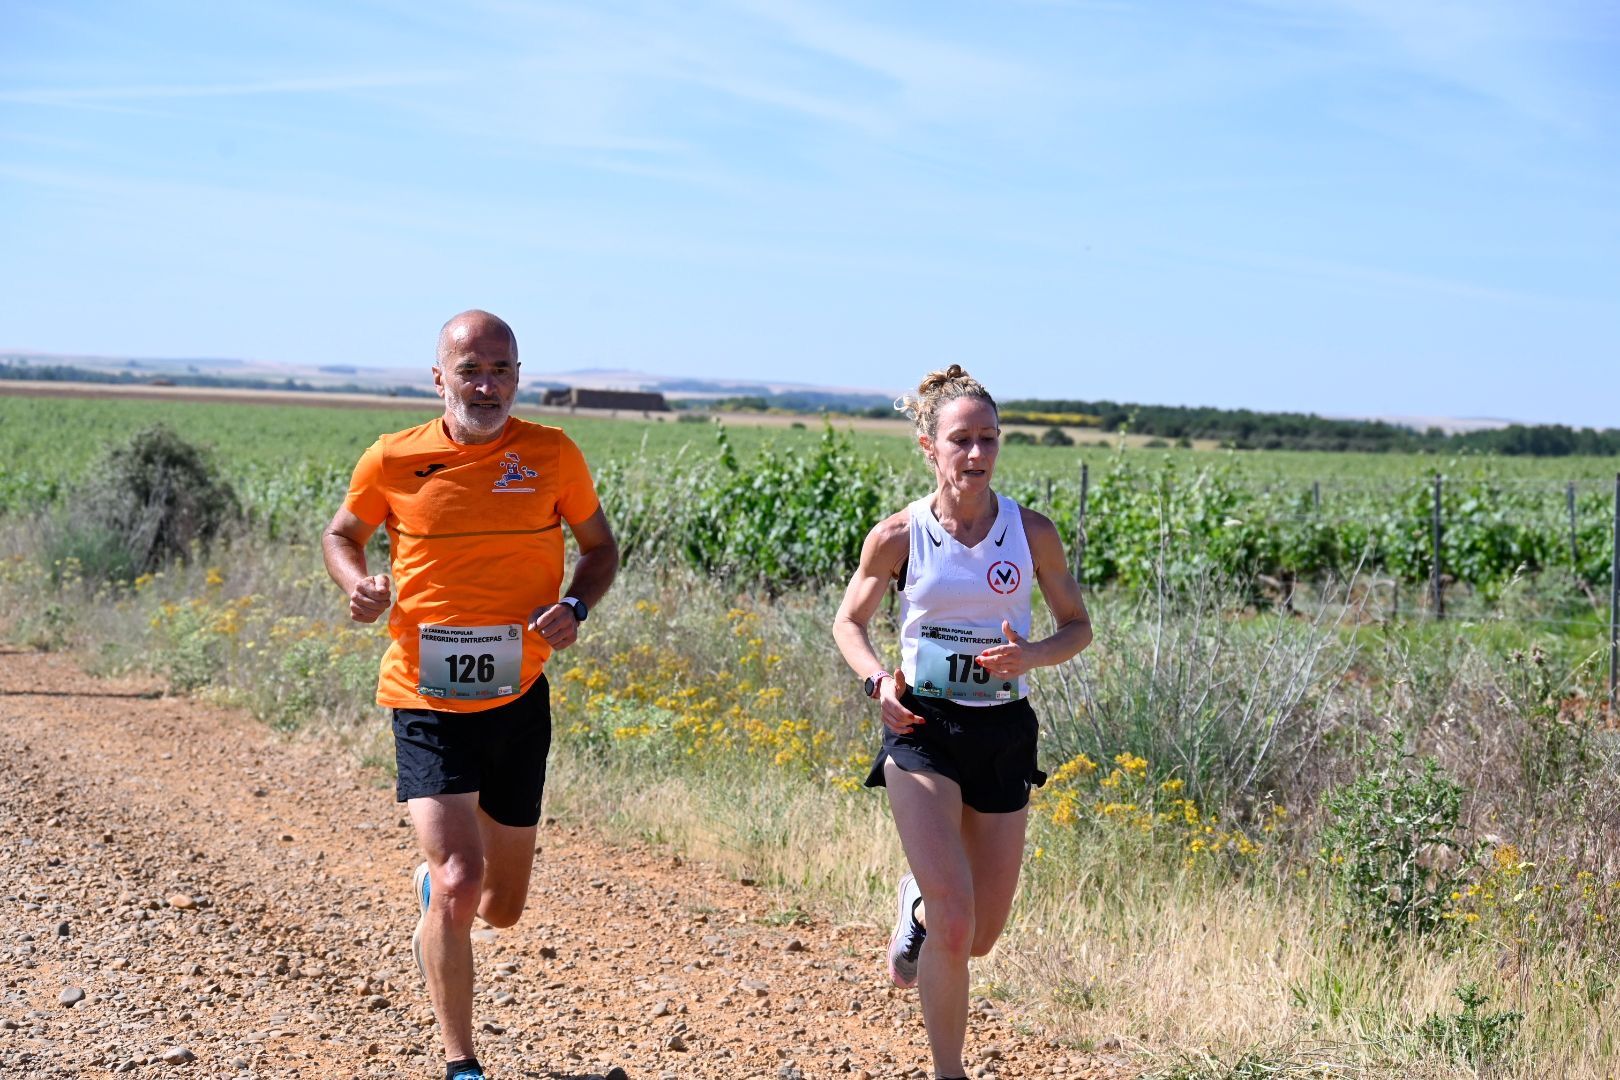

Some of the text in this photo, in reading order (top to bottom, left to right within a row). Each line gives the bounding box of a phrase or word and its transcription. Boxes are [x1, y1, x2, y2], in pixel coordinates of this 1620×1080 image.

[421, 634, 459, 643] PEREGRINO
[461, 635, 502, 643] ENTRECEPAS
[445, 654, 494, 683] 126
